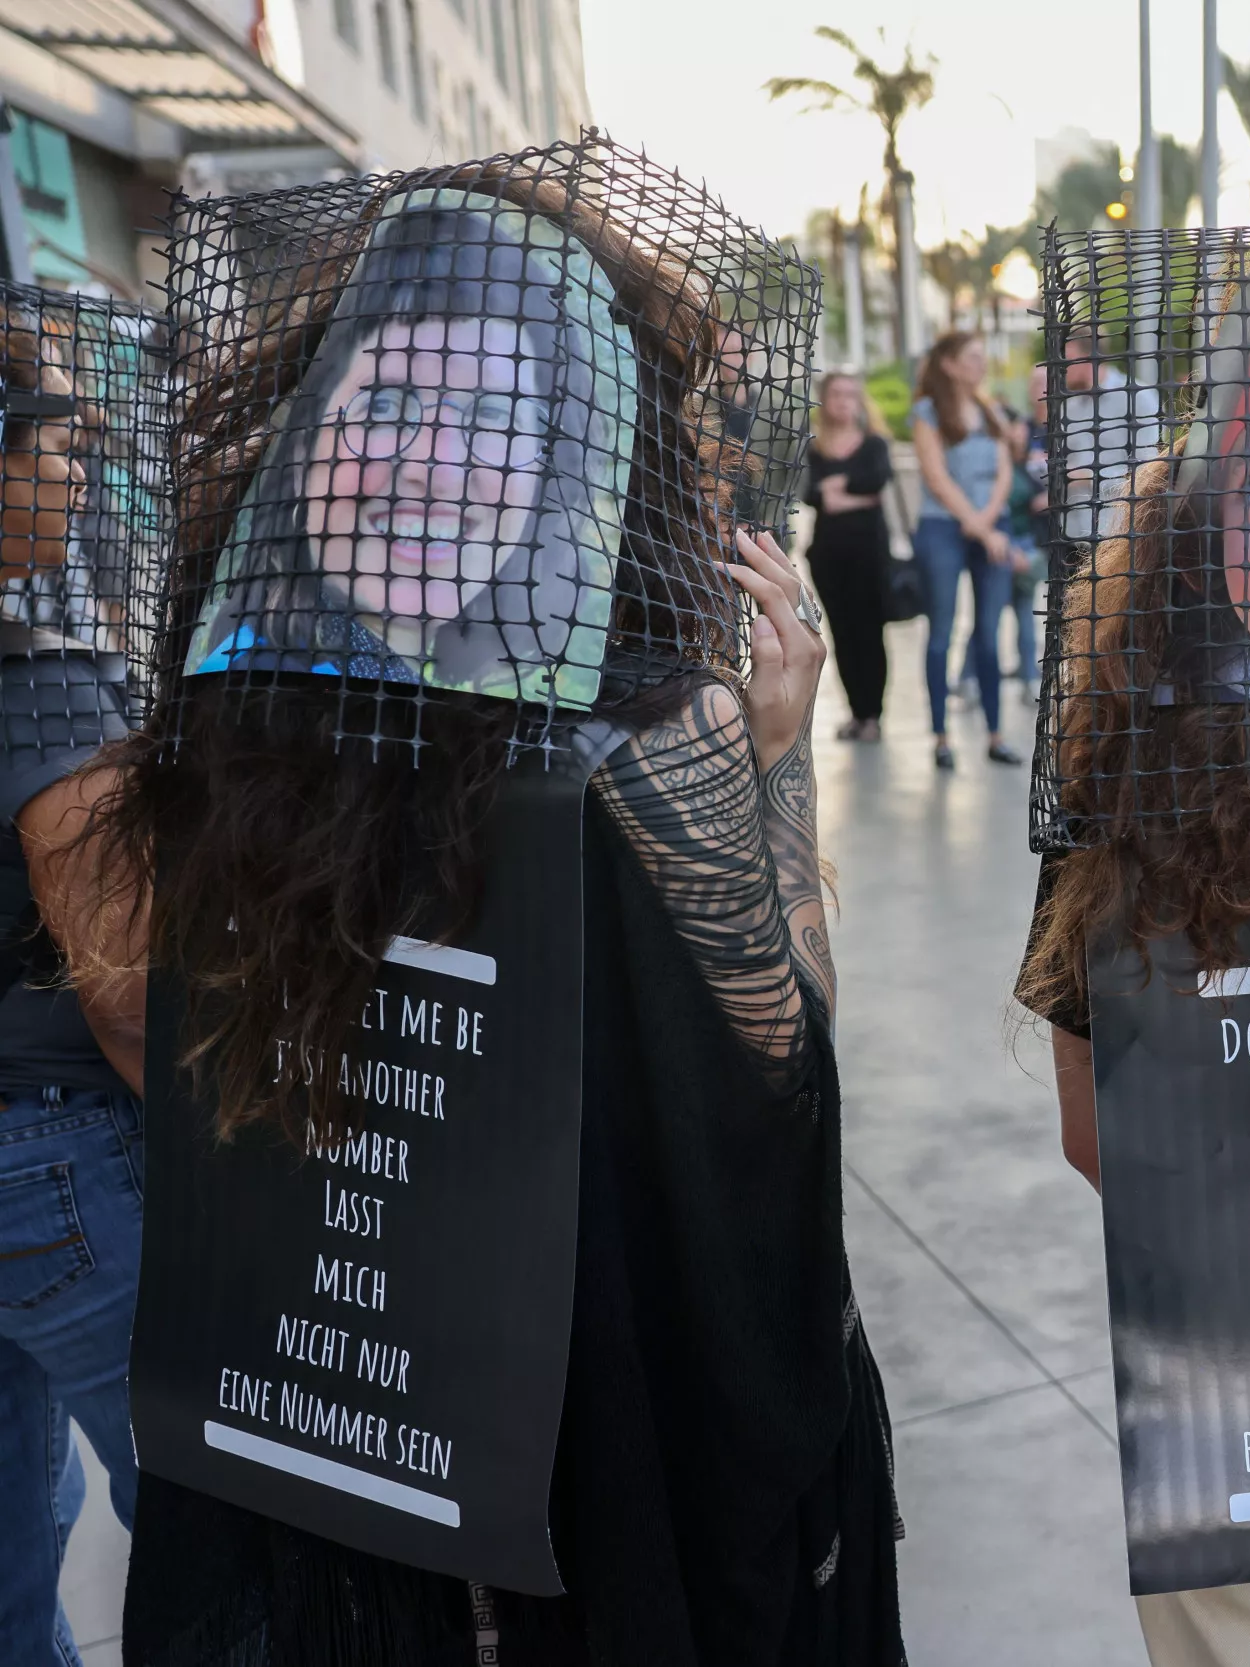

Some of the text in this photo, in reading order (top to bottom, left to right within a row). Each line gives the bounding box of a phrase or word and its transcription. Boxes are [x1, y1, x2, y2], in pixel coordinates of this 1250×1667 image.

[351, 988, 483, 1055] ET ME BE
[273, 1038, 444, 1120] JST ANOTHER
[306, 1119, 408, 1183] NUMBER
[325, 1180, 384, 1239] LASST
[315, 1254, 385, 1311] MICH
[277, 1314, 409, 1393] NICHT NUR
[220, 1368, 451, 1479] EINE NUMMER SEIN
